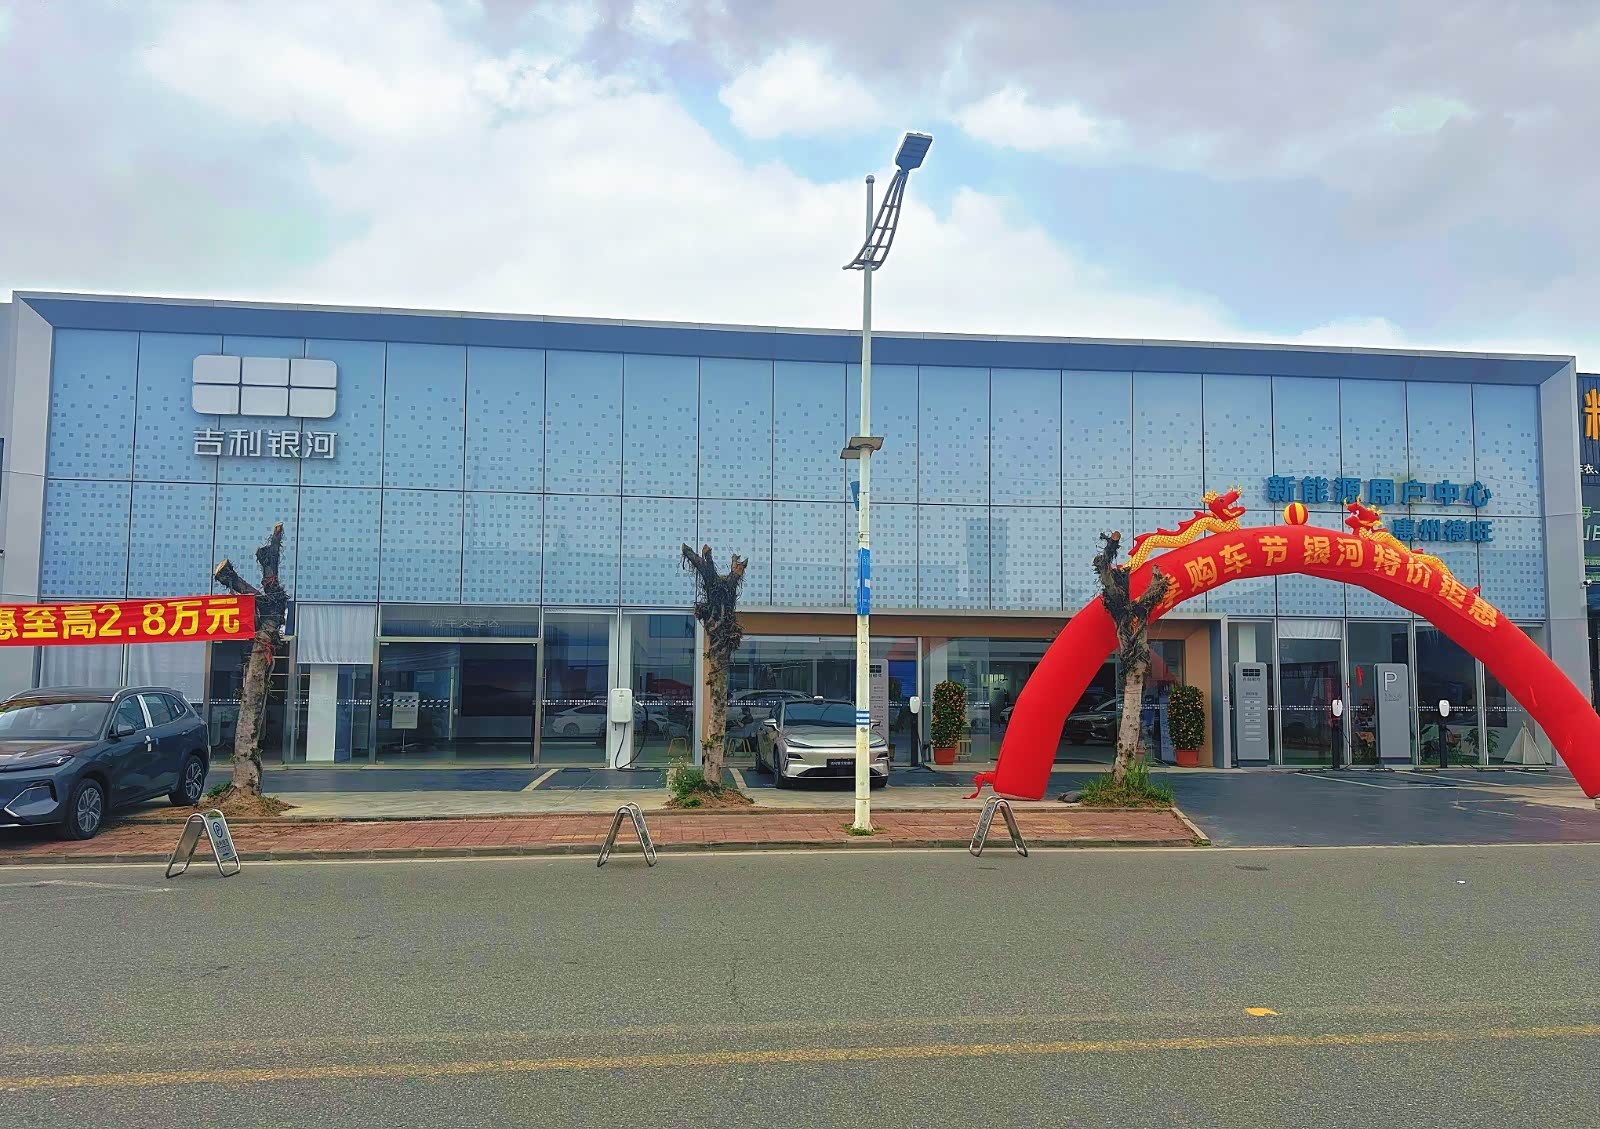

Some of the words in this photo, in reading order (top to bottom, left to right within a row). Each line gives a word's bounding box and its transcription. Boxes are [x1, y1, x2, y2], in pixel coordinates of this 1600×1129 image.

[193, 428, 338, 459] 吉利银河
[1266, 474, 1492, 508] 新能源用户中心
[1391, 518, 1494, 543] 惠州德旺
[1384, 671, 1398, 691] P
